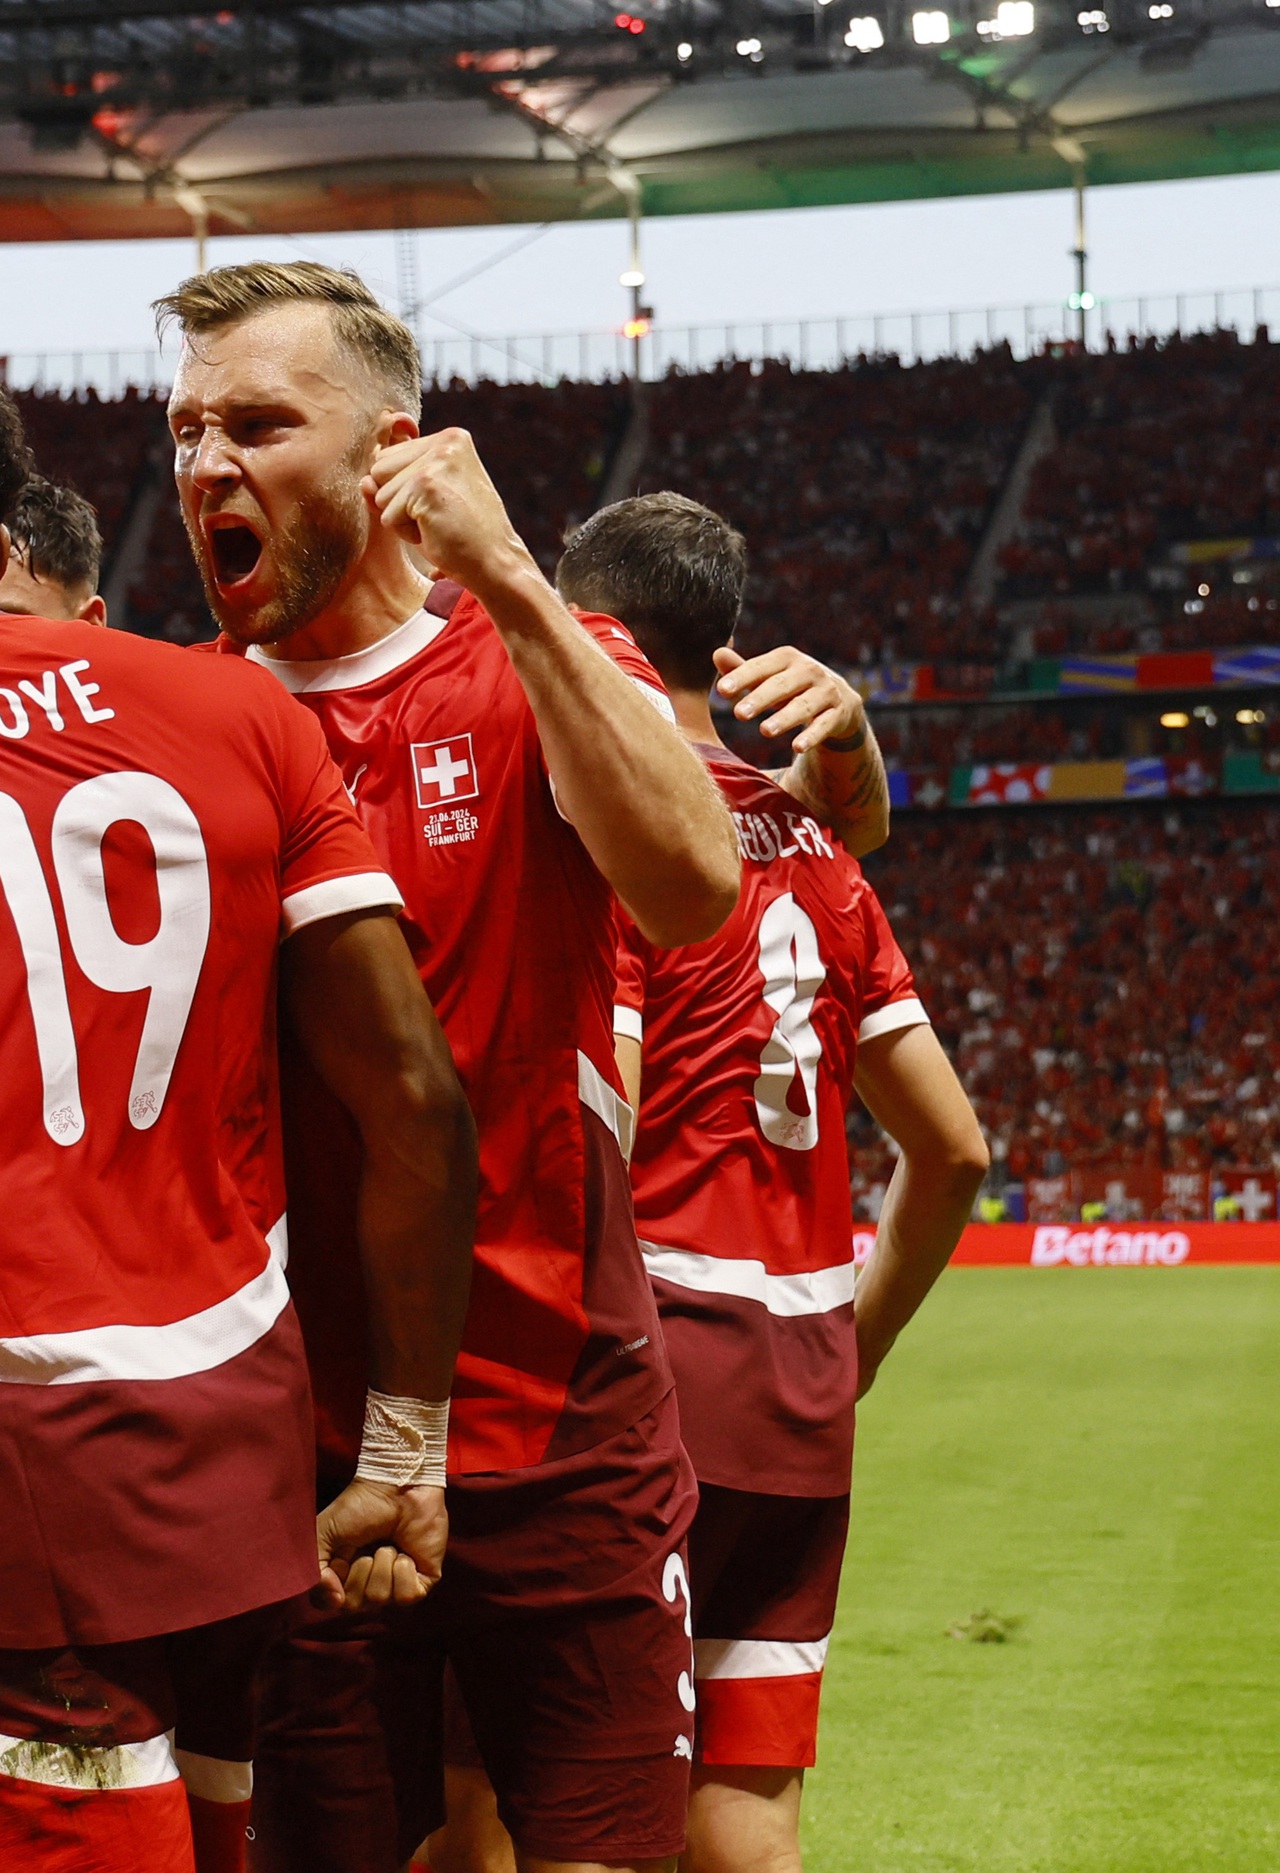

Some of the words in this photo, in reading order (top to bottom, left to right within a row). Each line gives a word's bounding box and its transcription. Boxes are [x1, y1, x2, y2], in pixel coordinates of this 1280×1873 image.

[423, 822, 442, 838] SUI
[456, 816, 479, 832] GER
[428, 830, 475, 847] FRANKFURT
[732, 811, 835, 862] EULER
[753, 891, 827, 1151] 8
[1030, 1225, 1191, 1266] Betano
